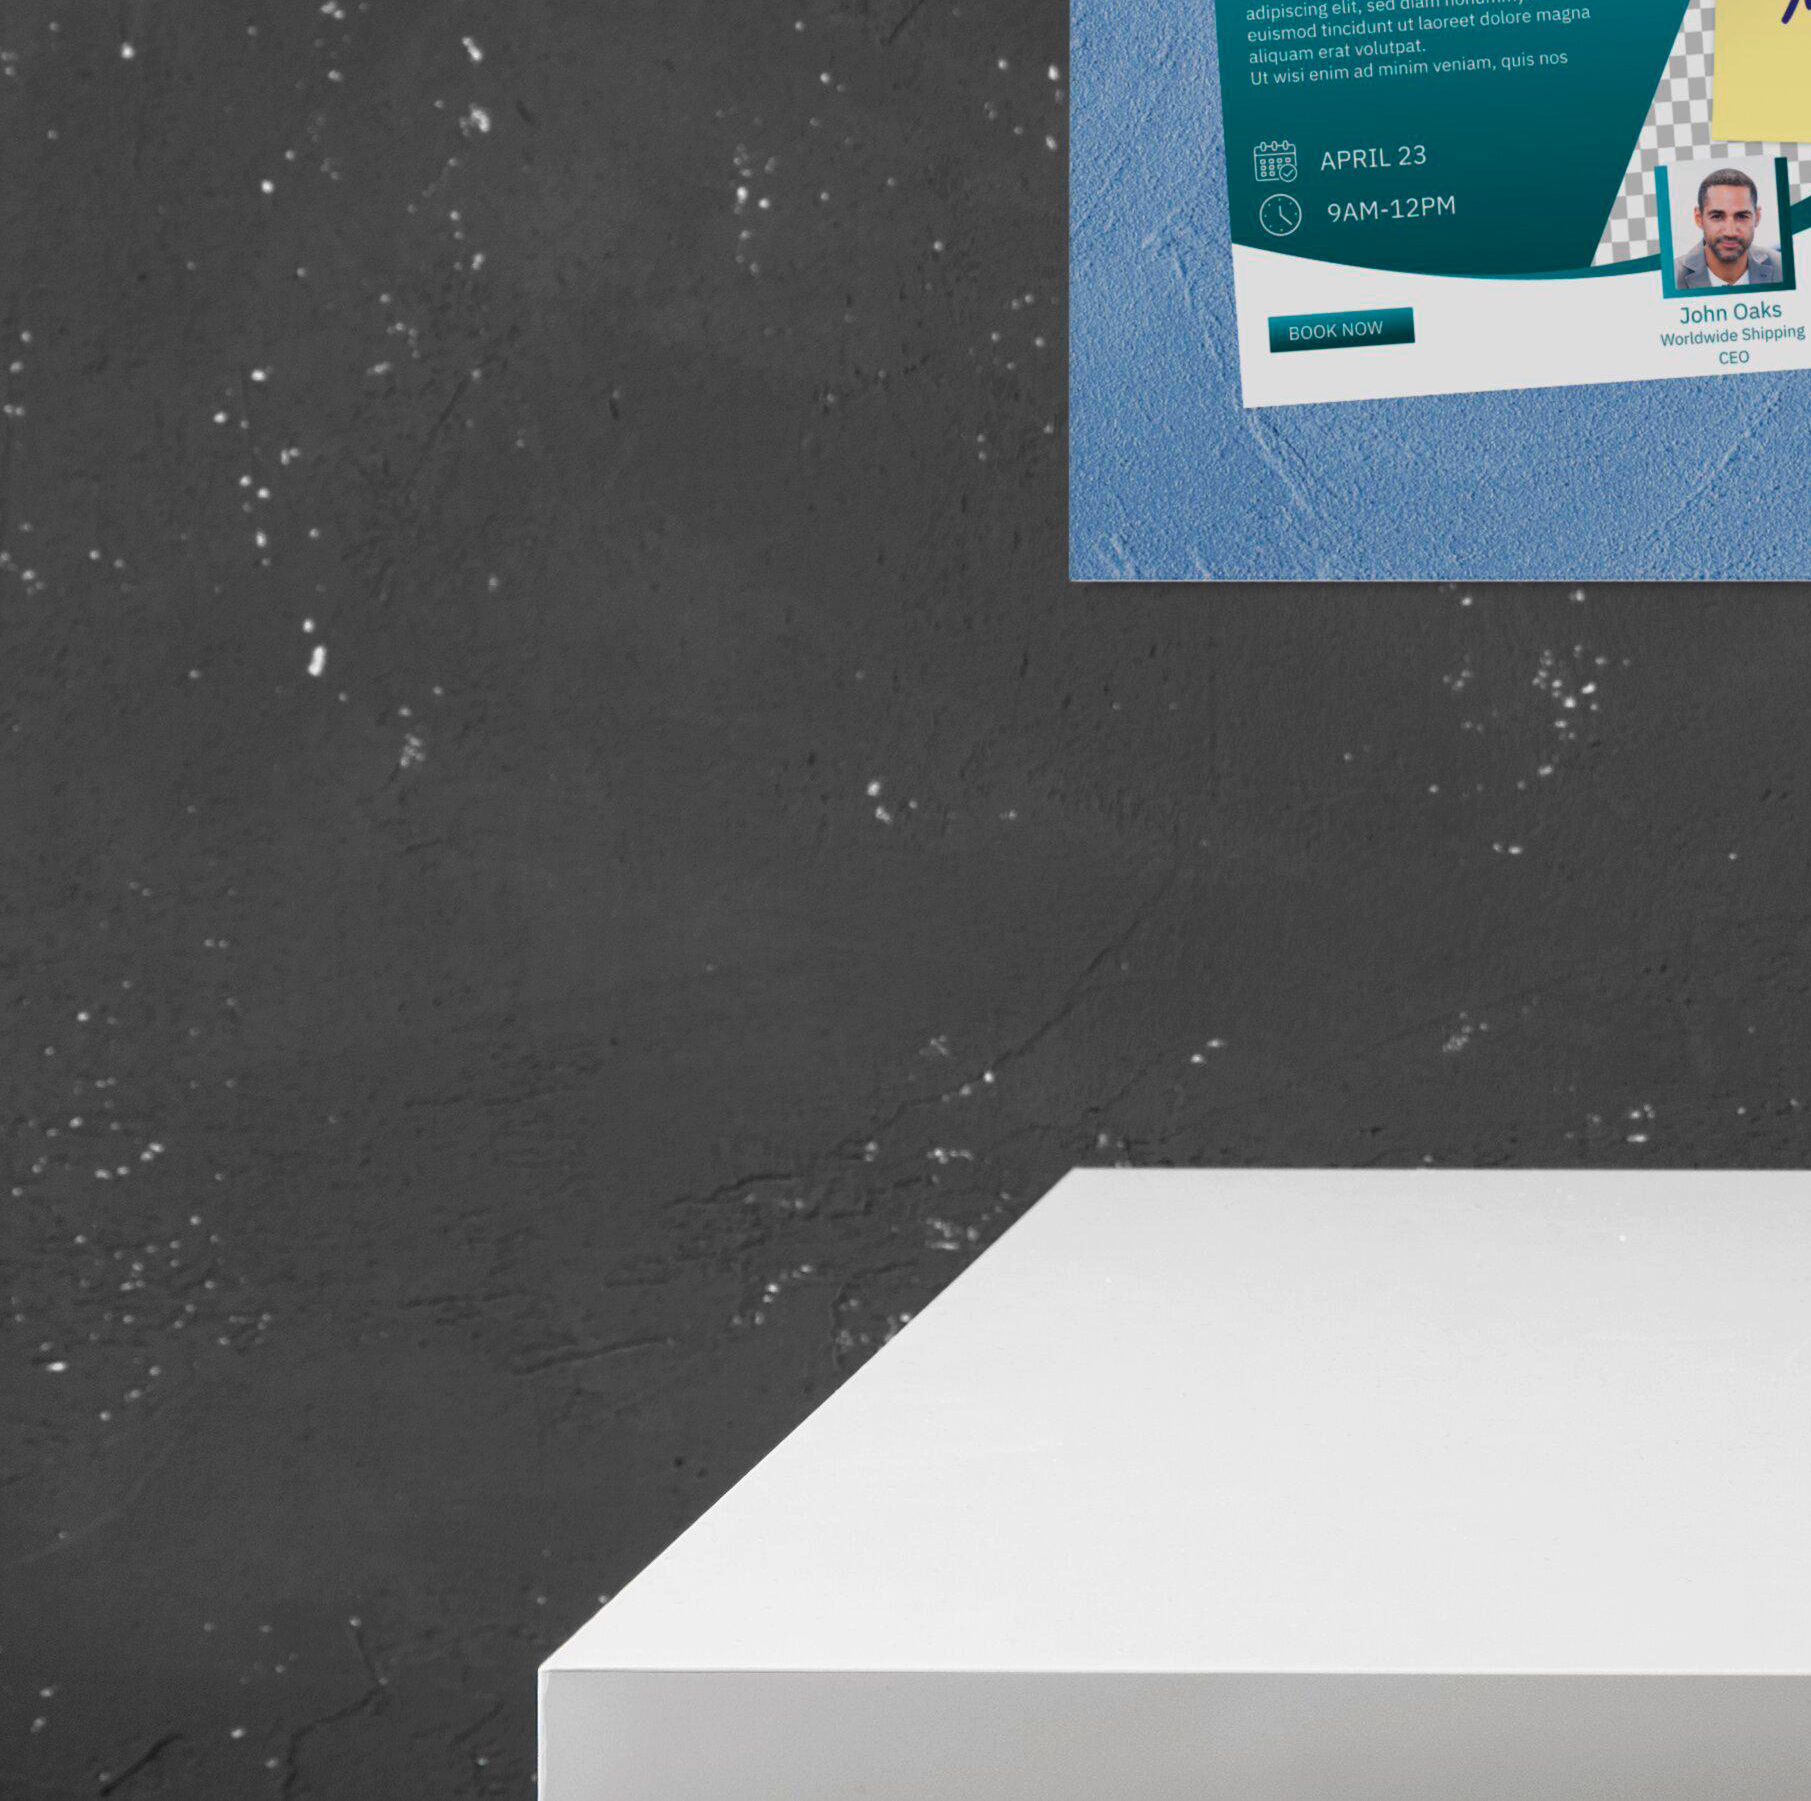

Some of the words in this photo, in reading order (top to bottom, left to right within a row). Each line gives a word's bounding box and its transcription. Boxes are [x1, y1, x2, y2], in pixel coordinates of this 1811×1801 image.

[1245, 1, 1330, 24] adipiscing
[1246, 22, 1318, 43] euismod
[1320, 18, 1394, 39] tincidunt
[1396, 16, 1415, 33] ut
[1417, 12, 1476, 31] laoreet
[1478, 9, 1533, 27] dolore
[1535, 6, 1592, 25] magna
[1248, 47, 1315, 67] aliquam
[1317, 43, 1351, 60] erat
[1353, 38, 1427, 58] volutpat.
[1249, 69, 1270, 87] Ut
[1272, 66, 1306, 85] wisi
[1308, 64, 1350, 83] enim
[1352, 61, 1374, 80] ad
[1377, 58, 1429, 77] minim
[1432, 55, 1498, 74] veniam,
[1500, 51, 1536, 72] quis
[1538, 51, 1569, 66] nos
[1319, 146, 1393, 172] APRIL
[1397, 143, 1428, 167] 23
[1326, 194, 1457, 224] 9AM-12PM
[1679, 303, 1729, 326] John
[1732, 299, 1783, 322] Oaks
[1288, 322, 1338, 342] BOOK
[1341, 319, 1384, 338] NOW
[1659, 327, 1740, 348] Worldwide
[1740, 323, 1807, 344] Shipping
[1717, 349, 1751, 366] CEO
